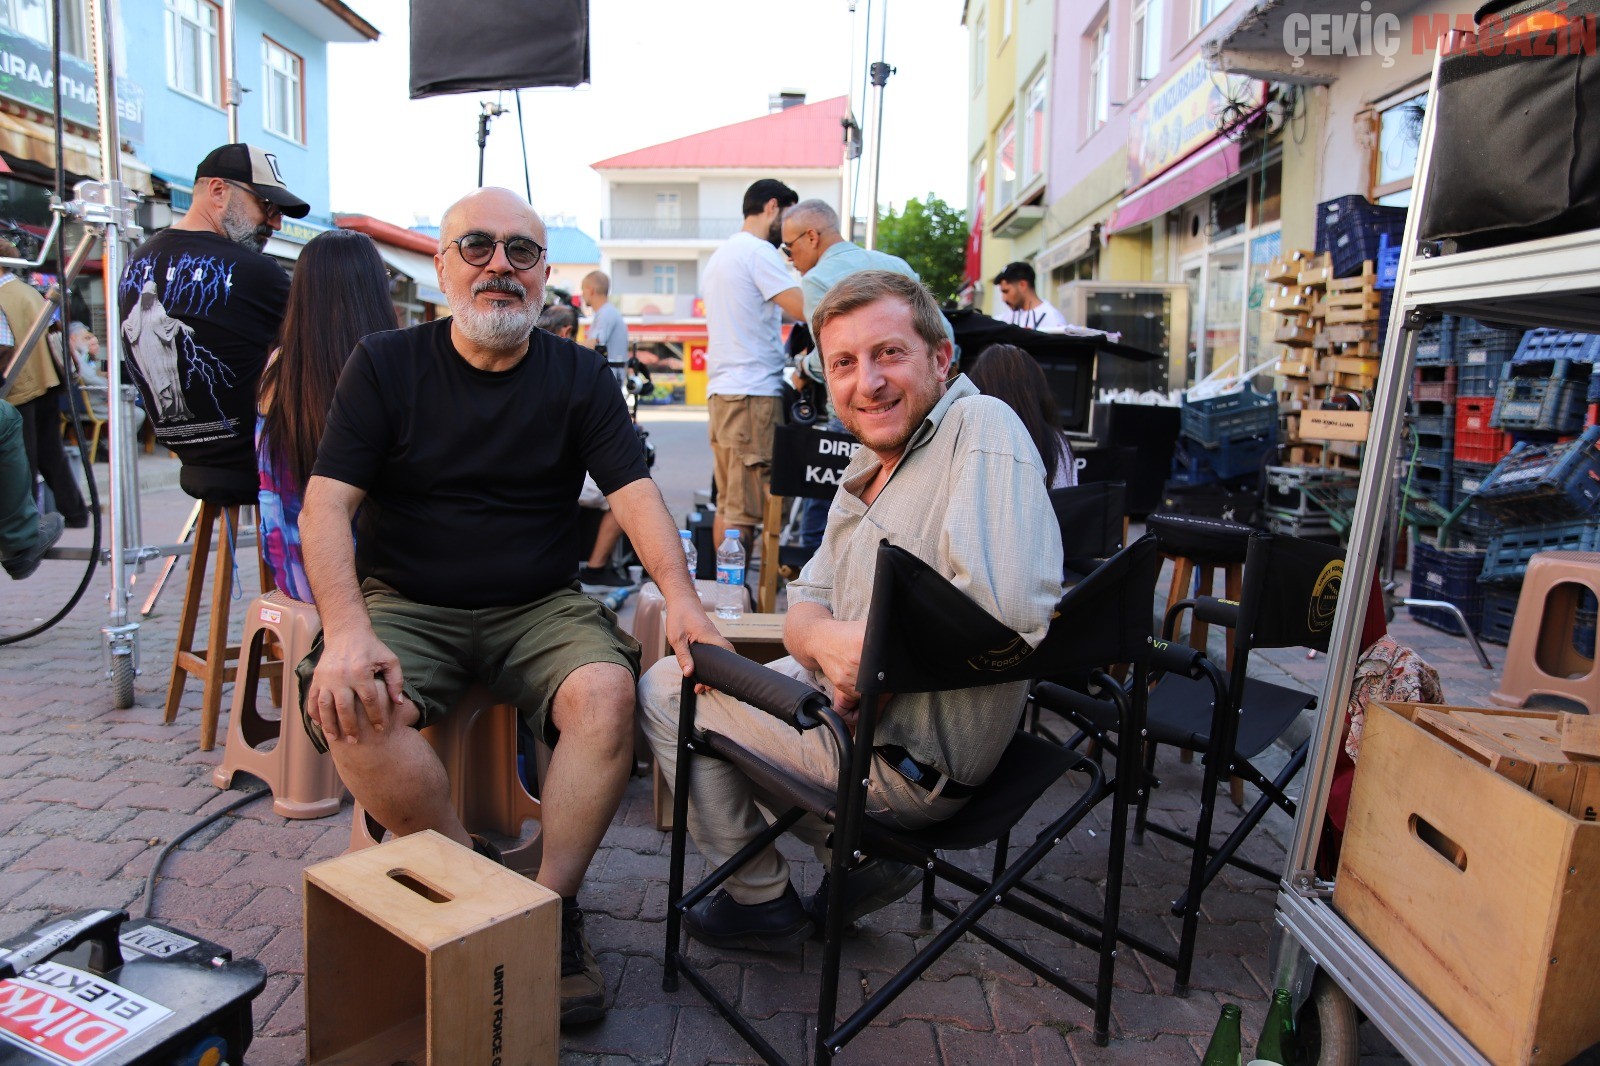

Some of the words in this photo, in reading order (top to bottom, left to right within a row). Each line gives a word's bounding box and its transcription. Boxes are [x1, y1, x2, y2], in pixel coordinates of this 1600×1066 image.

[0, 48, 142, 123] IRAATHAESİ
[493, 964, 504, 1006] UNITY
[0, 984, 122, 1053] DİKK
[492, 1008, 503, 1056] FORCE
